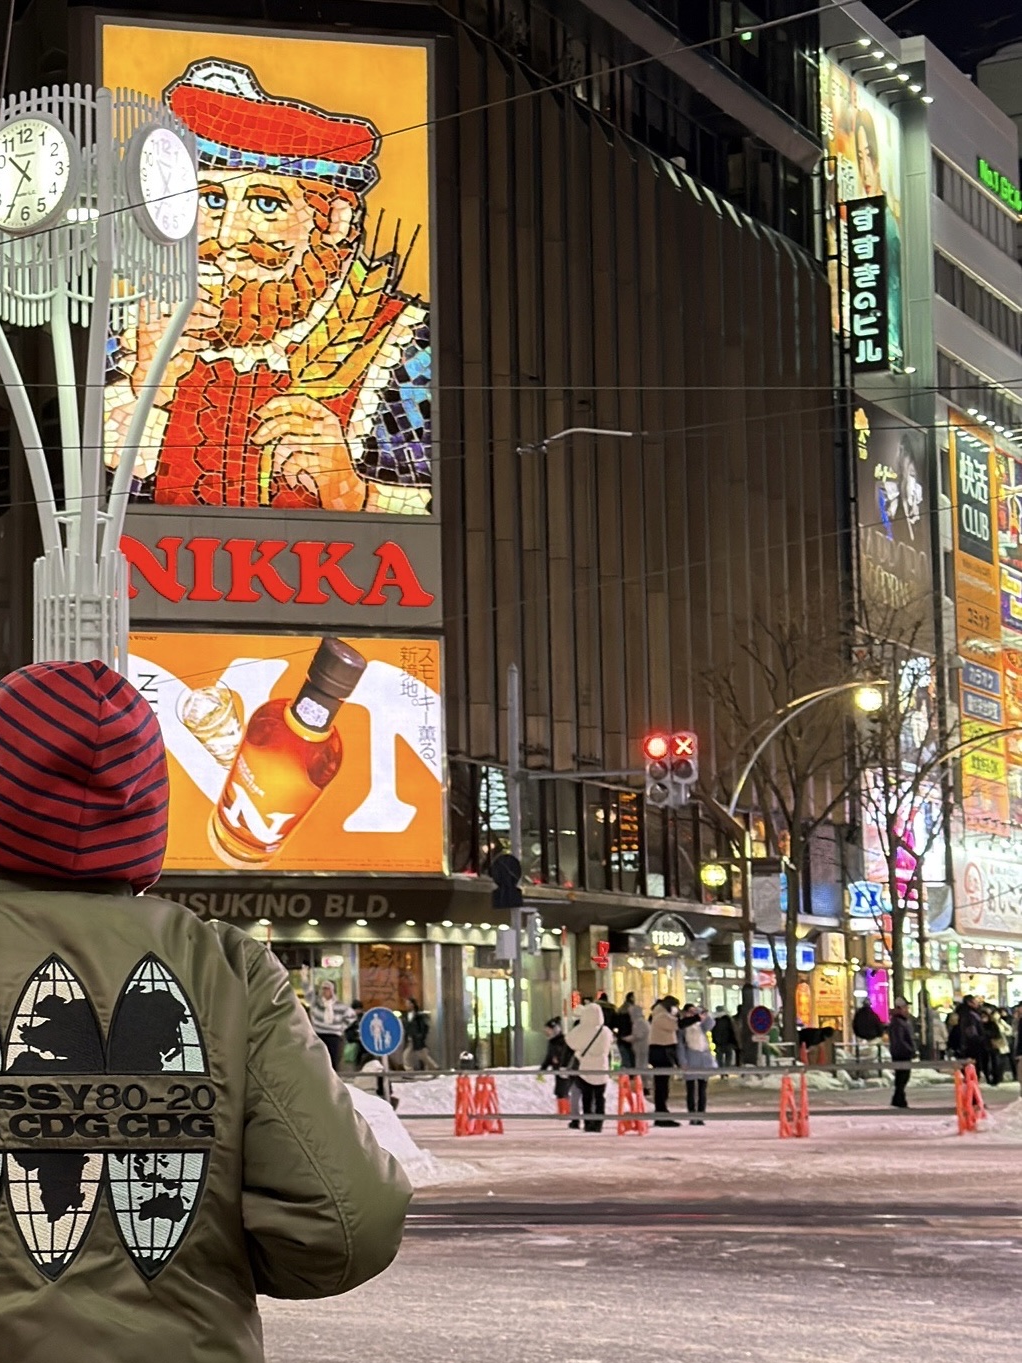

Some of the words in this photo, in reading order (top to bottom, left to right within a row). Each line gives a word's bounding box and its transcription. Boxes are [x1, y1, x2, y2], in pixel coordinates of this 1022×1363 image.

[50, 142, 60, 157] 2
[55, 161, 65, 176] 3
[20, 206, 31, 222] 6
[37, 197, 47, 213] 5
[850, 205, 883, 364] すすきのビル
[119, 535, 435, 608] NIKKA
[324, 894, 396, 918] BLD.
[95, 1083, 216, 1111] 80-20
[8, 1112, 111, 1140] CDG
[116, 1112, 216, 1139] CDG
